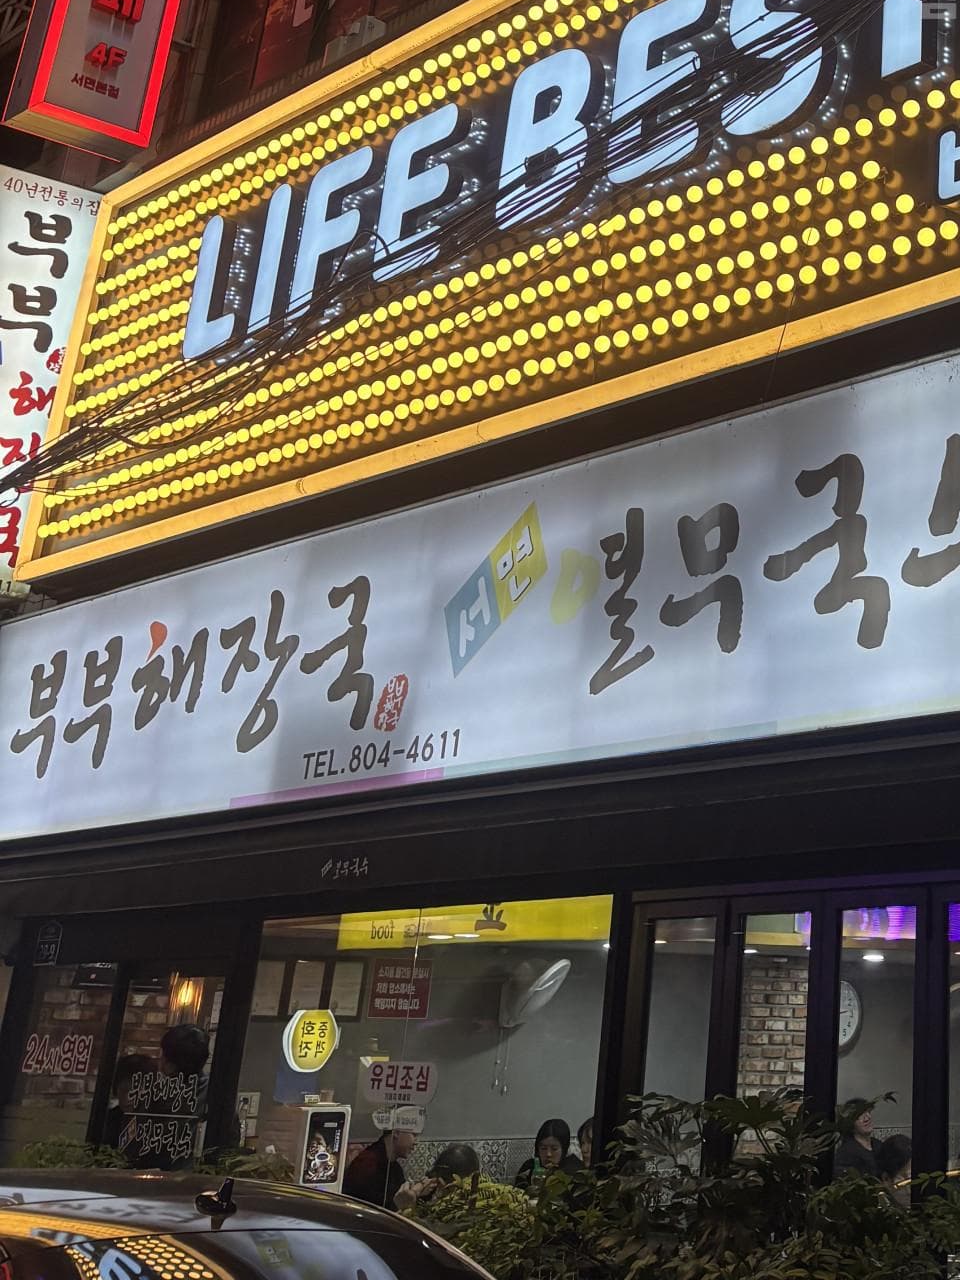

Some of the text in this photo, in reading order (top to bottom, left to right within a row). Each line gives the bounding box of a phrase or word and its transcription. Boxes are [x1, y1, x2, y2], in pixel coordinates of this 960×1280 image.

[84, 41, 128, 72] 4F
[71, 73, 121, 100] 서면본점
[182, 103, 459, 360] LIFE
[0, 210, 73, 353] 부부
[10, 575, 375, 780] 부부해장국
[127, 1072, 200, 1113] 부부해장국
[370, 1063, 431, 1092] 유리조심
